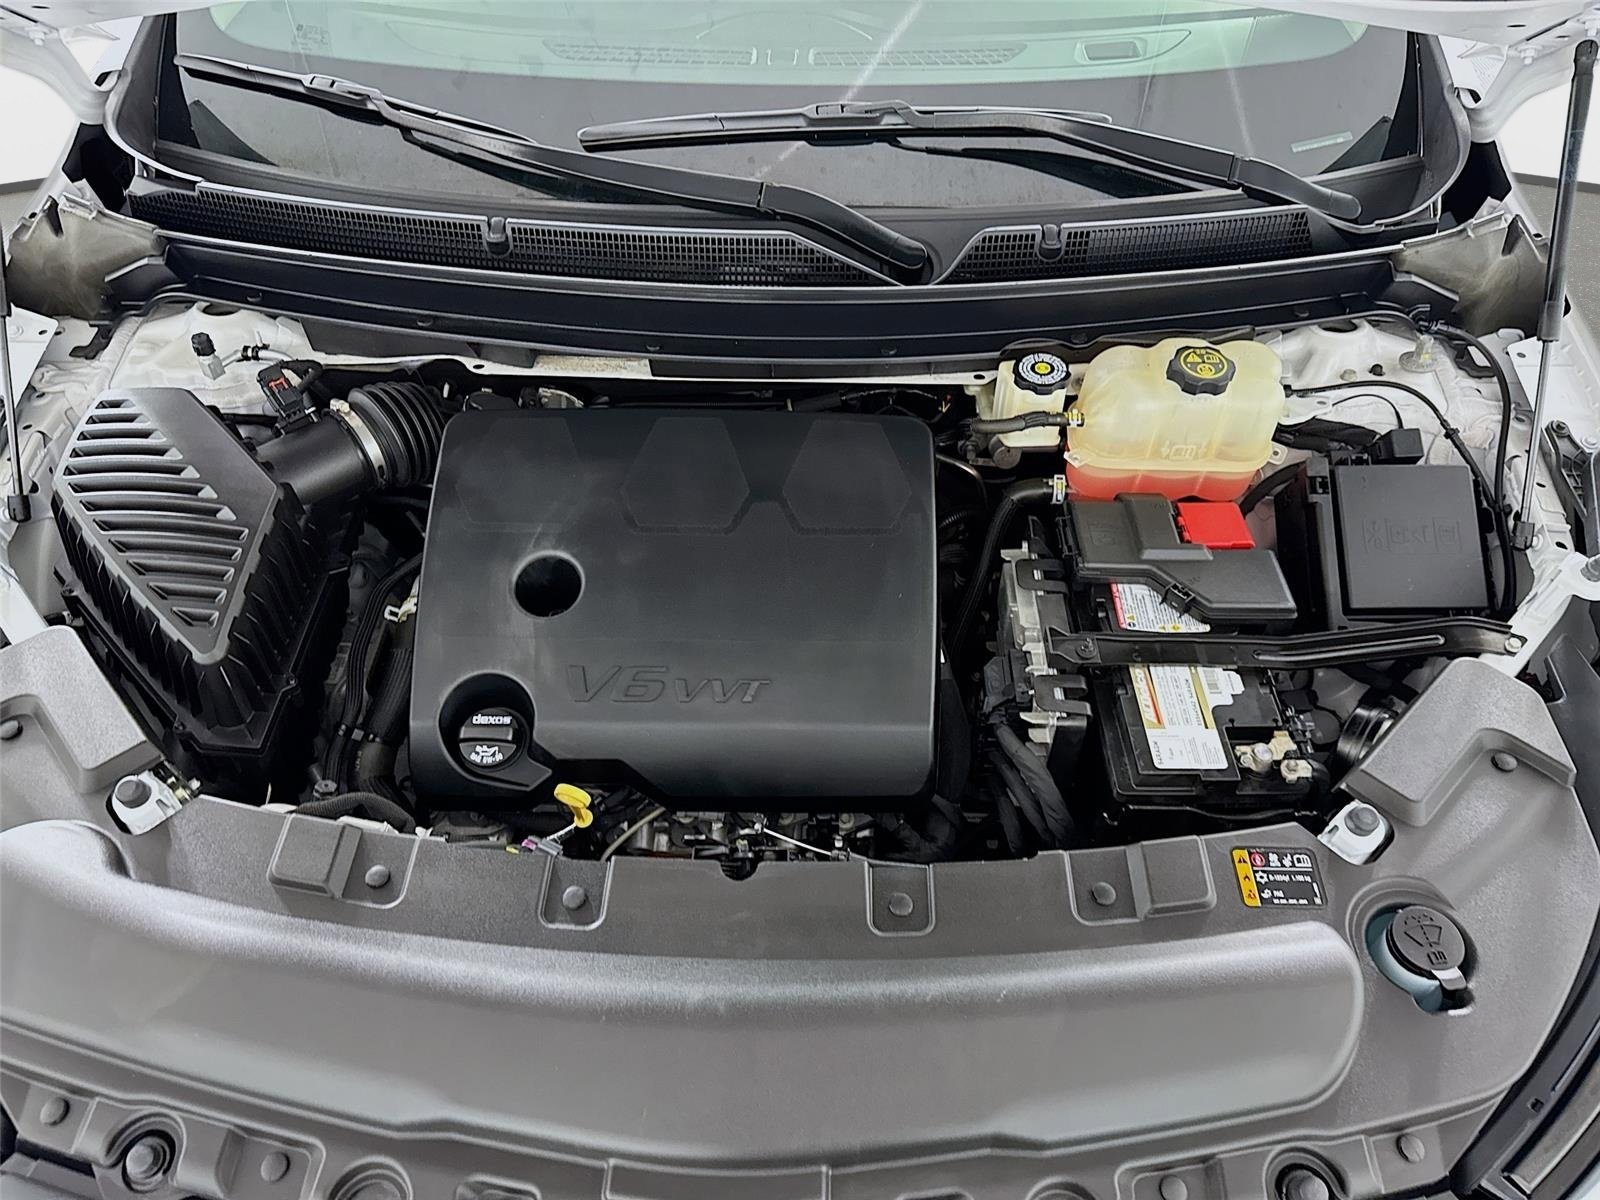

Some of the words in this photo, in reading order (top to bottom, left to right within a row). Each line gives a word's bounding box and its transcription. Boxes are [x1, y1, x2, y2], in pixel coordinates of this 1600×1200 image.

[567, 664, 669, 702] V6
[675, 677, 771, 703] VVT
[472, 713, 512, 725] dexos
